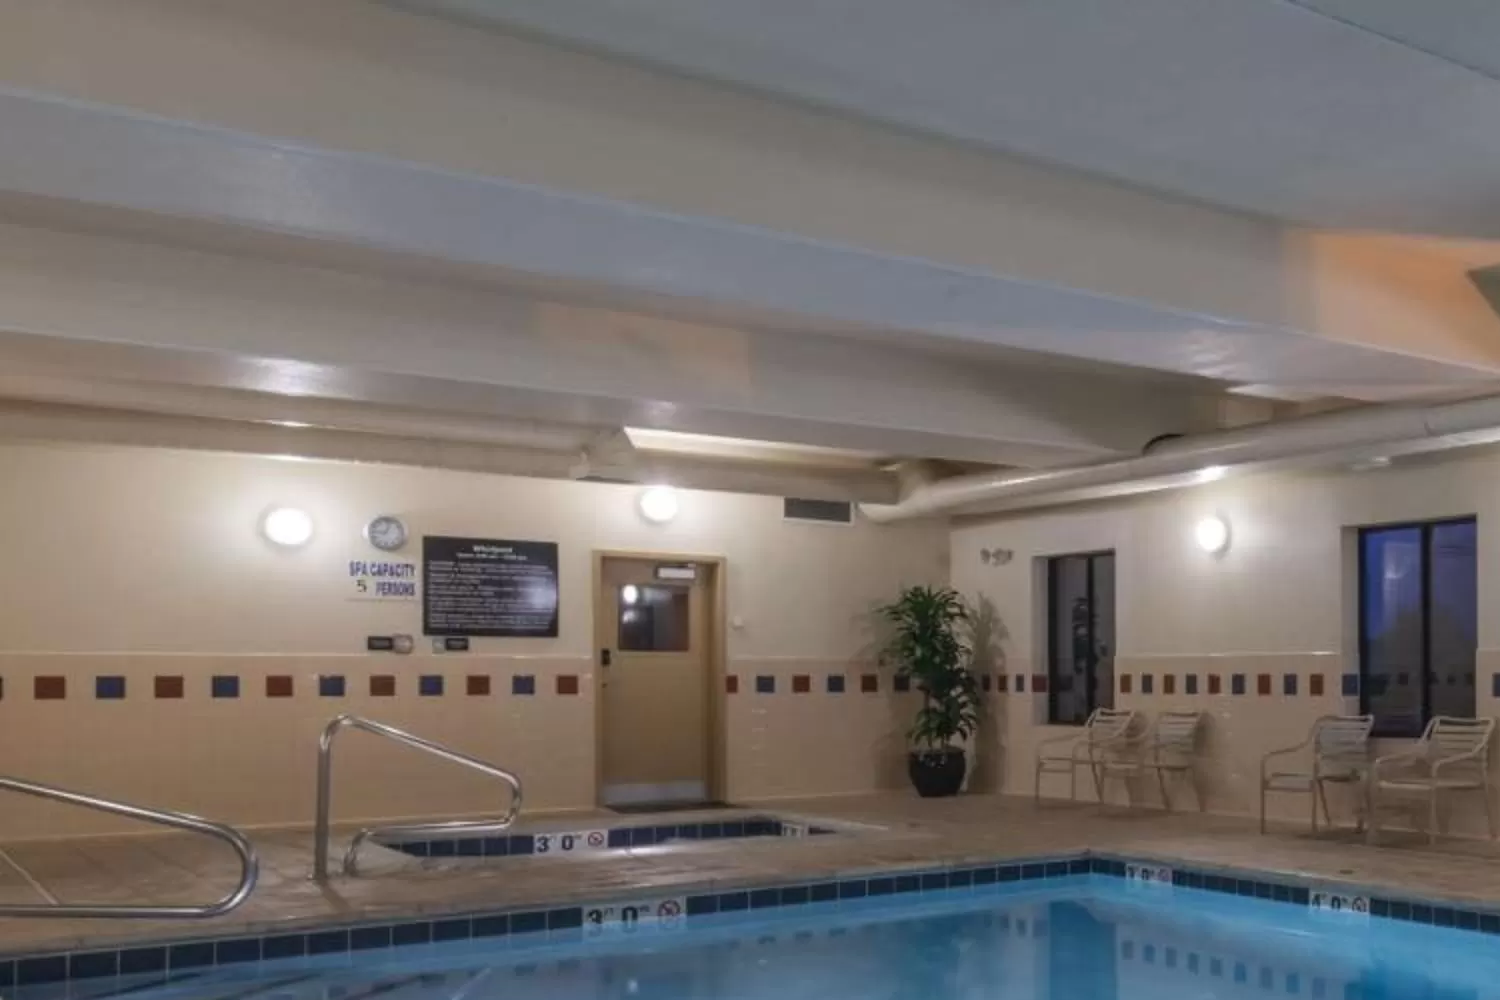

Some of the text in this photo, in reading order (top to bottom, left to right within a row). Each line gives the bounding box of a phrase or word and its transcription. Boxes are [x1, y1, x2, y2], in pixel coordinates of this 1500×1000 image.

[349, 560, 415, 577] SPA CAPACITY
[375, 581, 416, 596] PERSONS
